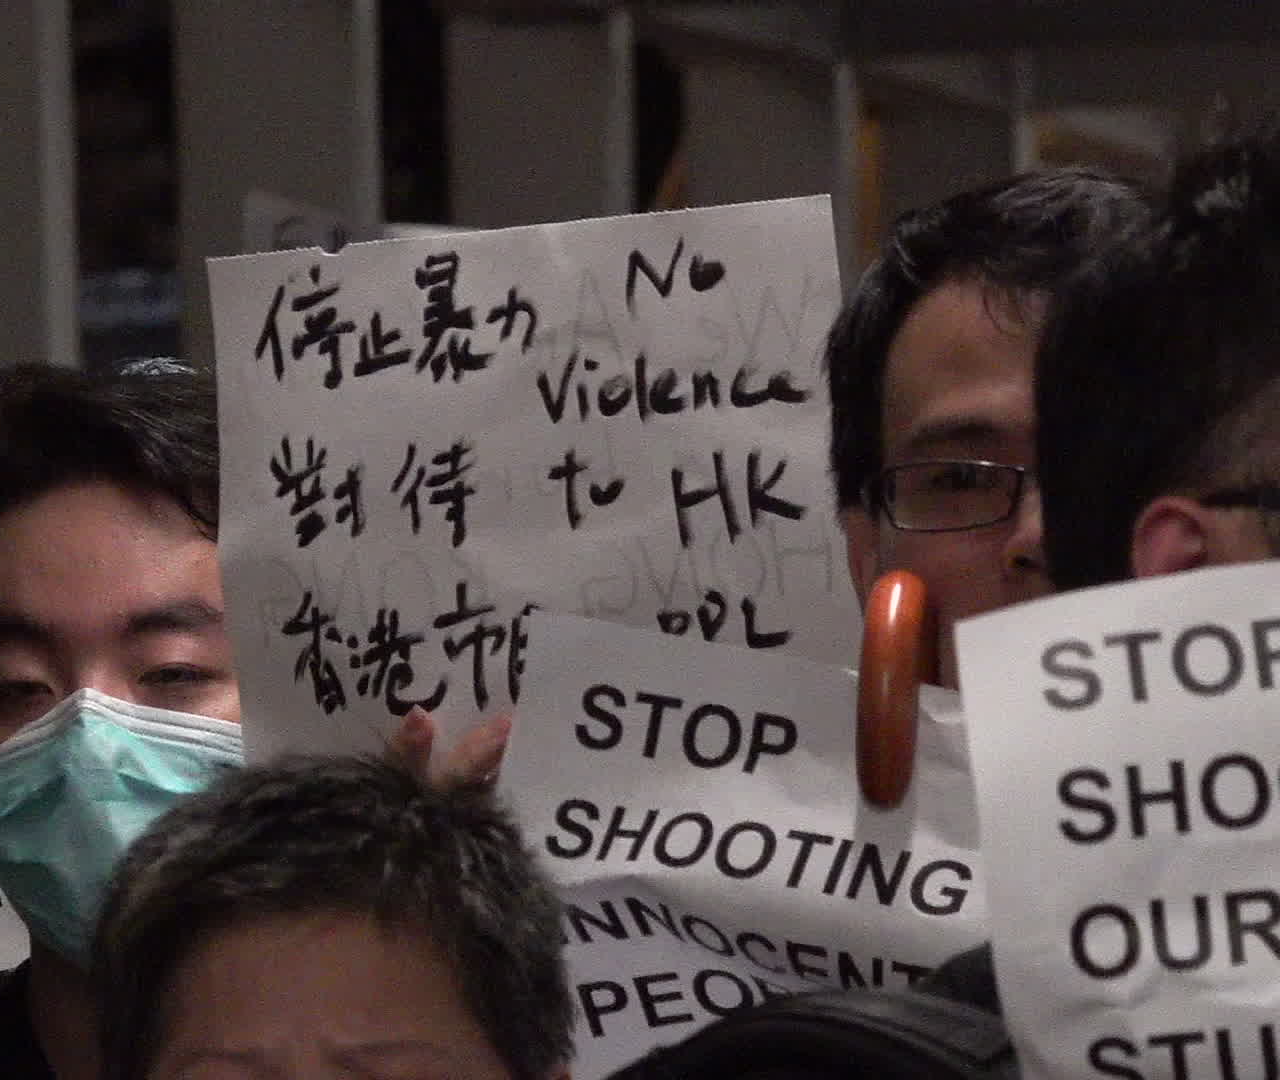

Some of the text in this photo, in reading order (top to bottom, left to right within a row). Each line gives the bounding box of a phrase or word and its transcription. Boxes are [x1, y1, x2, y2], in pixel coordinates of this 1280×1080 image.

[255, 251, 538, 389] 停止暴力
[627, 238, 726, 309] No
[537, 350, 815, 424] Violence
[549, 449, 806, 548] to HK
[575, 684, 798, 773] STOP
[545, 799, 973, 915] SHOOTING
[562, 897, 940, 992] NNOCENT
